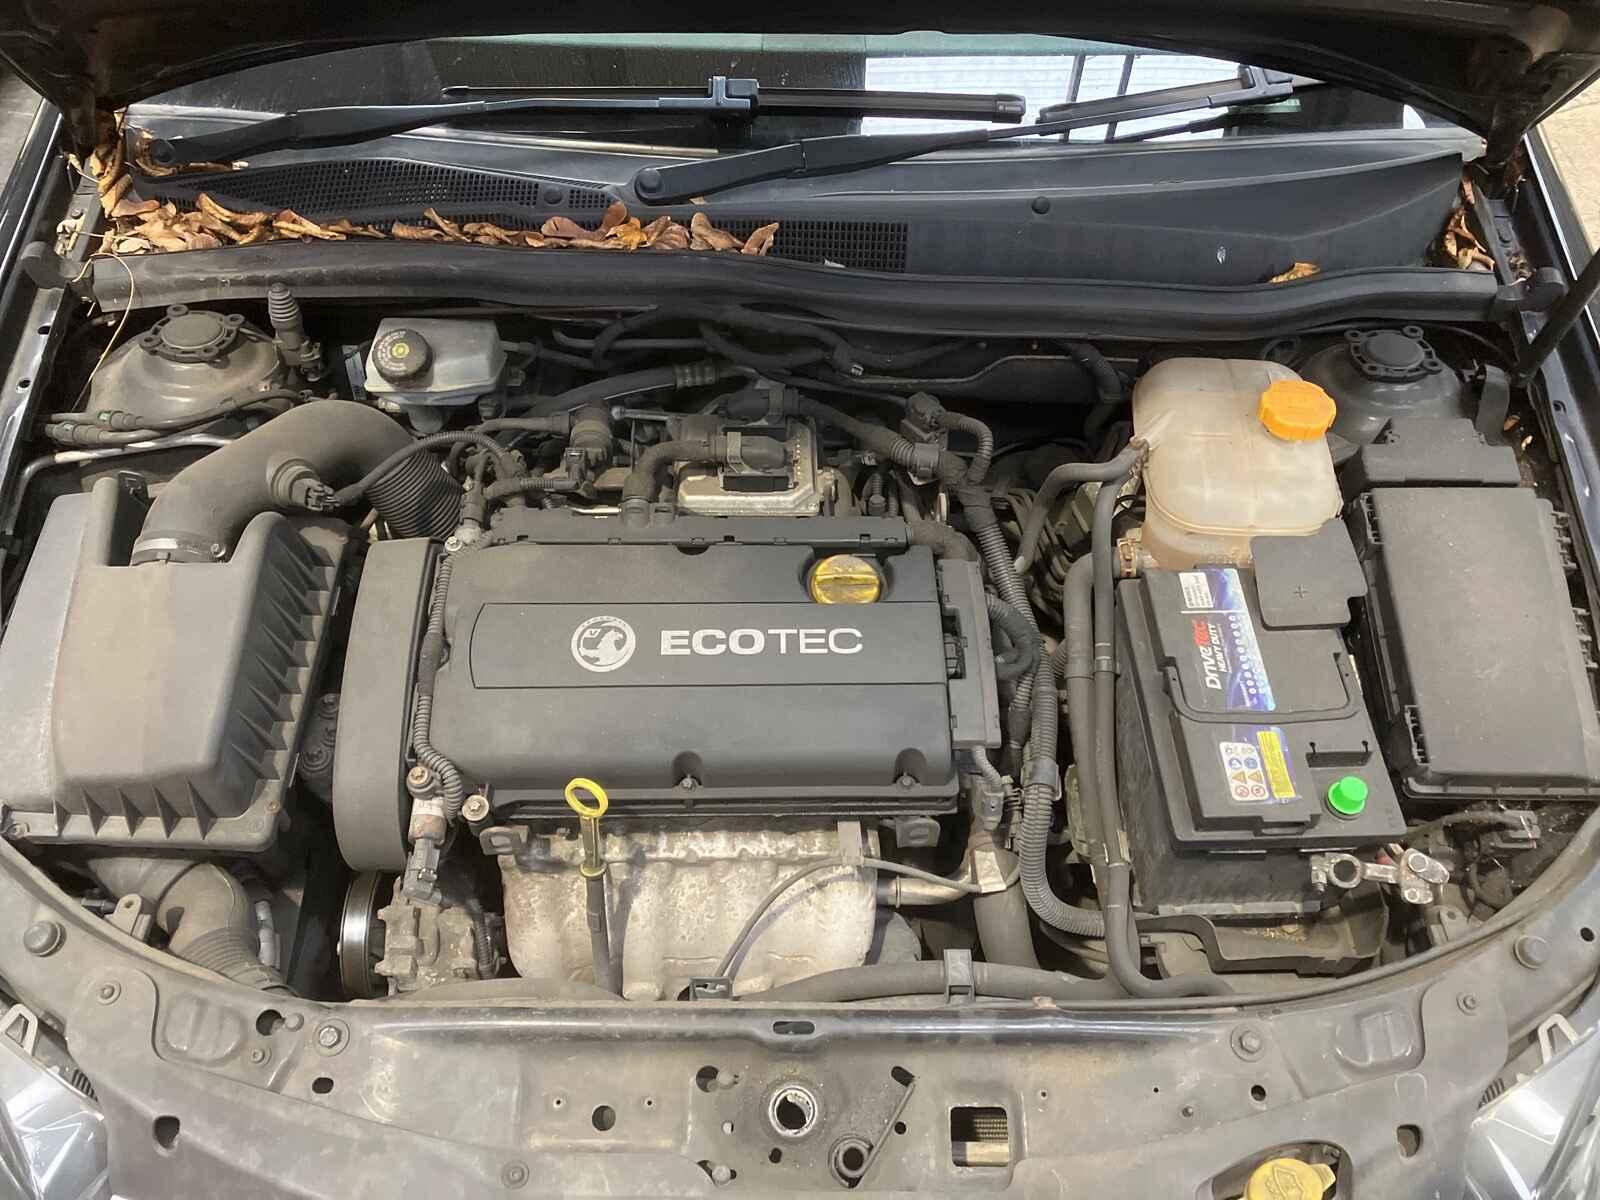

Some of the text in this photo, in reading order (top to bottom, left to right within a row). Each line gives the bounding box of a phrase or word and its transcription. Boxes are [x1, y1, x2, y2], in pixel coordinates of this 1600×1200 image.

[660, 627, 864, 655] ECOTEC
[1207, 623, 1221, 645] DUTY
[1212, 644, 1228, 673] HEAVY
